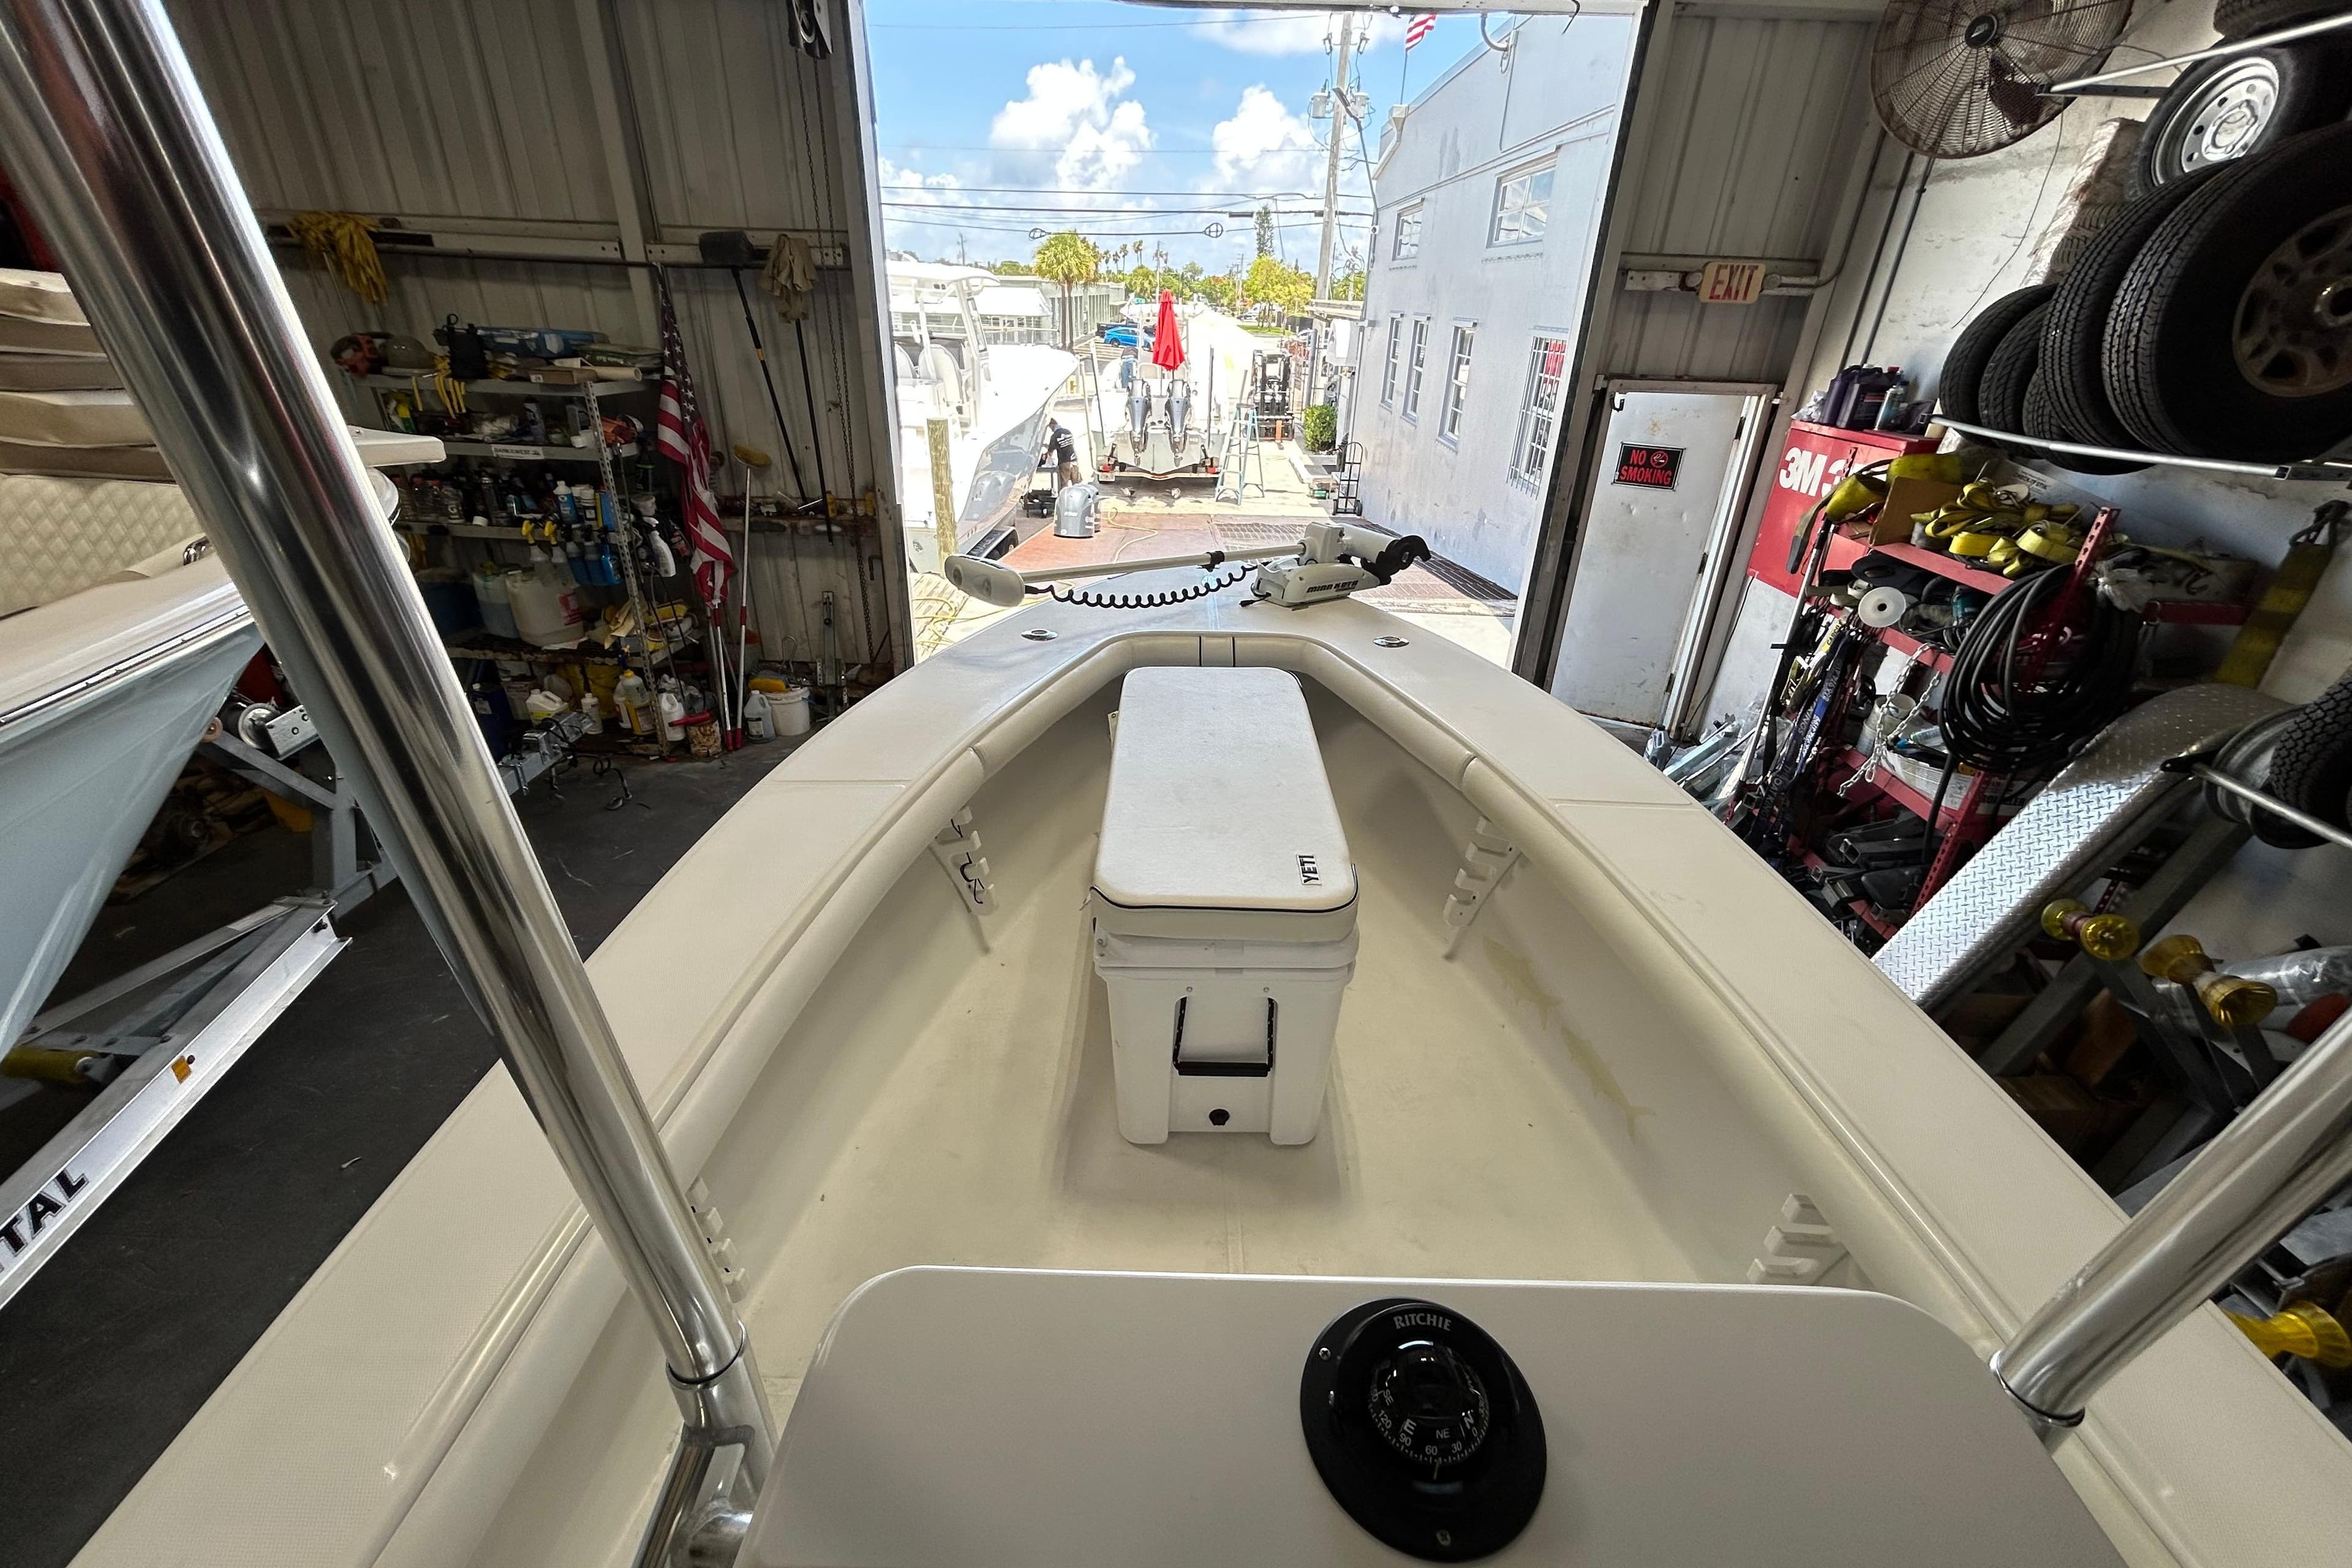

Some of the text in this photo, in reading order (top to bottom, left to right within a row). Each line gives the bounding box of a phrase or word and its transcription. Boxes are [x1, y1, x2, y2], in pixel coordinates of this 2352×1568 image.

[1709, 264, 1759, 301] EXIT
[1630, 450, 1646, 466] NO
[1619, 466, 1672, 485] SMOKING
[1779, 447, 1828, 497] 3M
[1298, 855, 1319, 884] YETI
[0, 1168, 89, 1262] TAL
[1393, 1313, 1452, 1332] RITCHIE
[1382, 1389, 1394, 1406] SE
[1379, 1409, 1392, 1429] 120
[1403, 1419, 1417, 1435] E
[1464, 1412, 1474, 1430] N
[1399, 1433, 1412, 1446] 90
[1436, 1428, 1450, 1439] NE
[1472, 1427, 1478, 1437] 0
[1425, 1445, 1438, 1456] 60
[1451, 1441, 1463, 1453] 30
